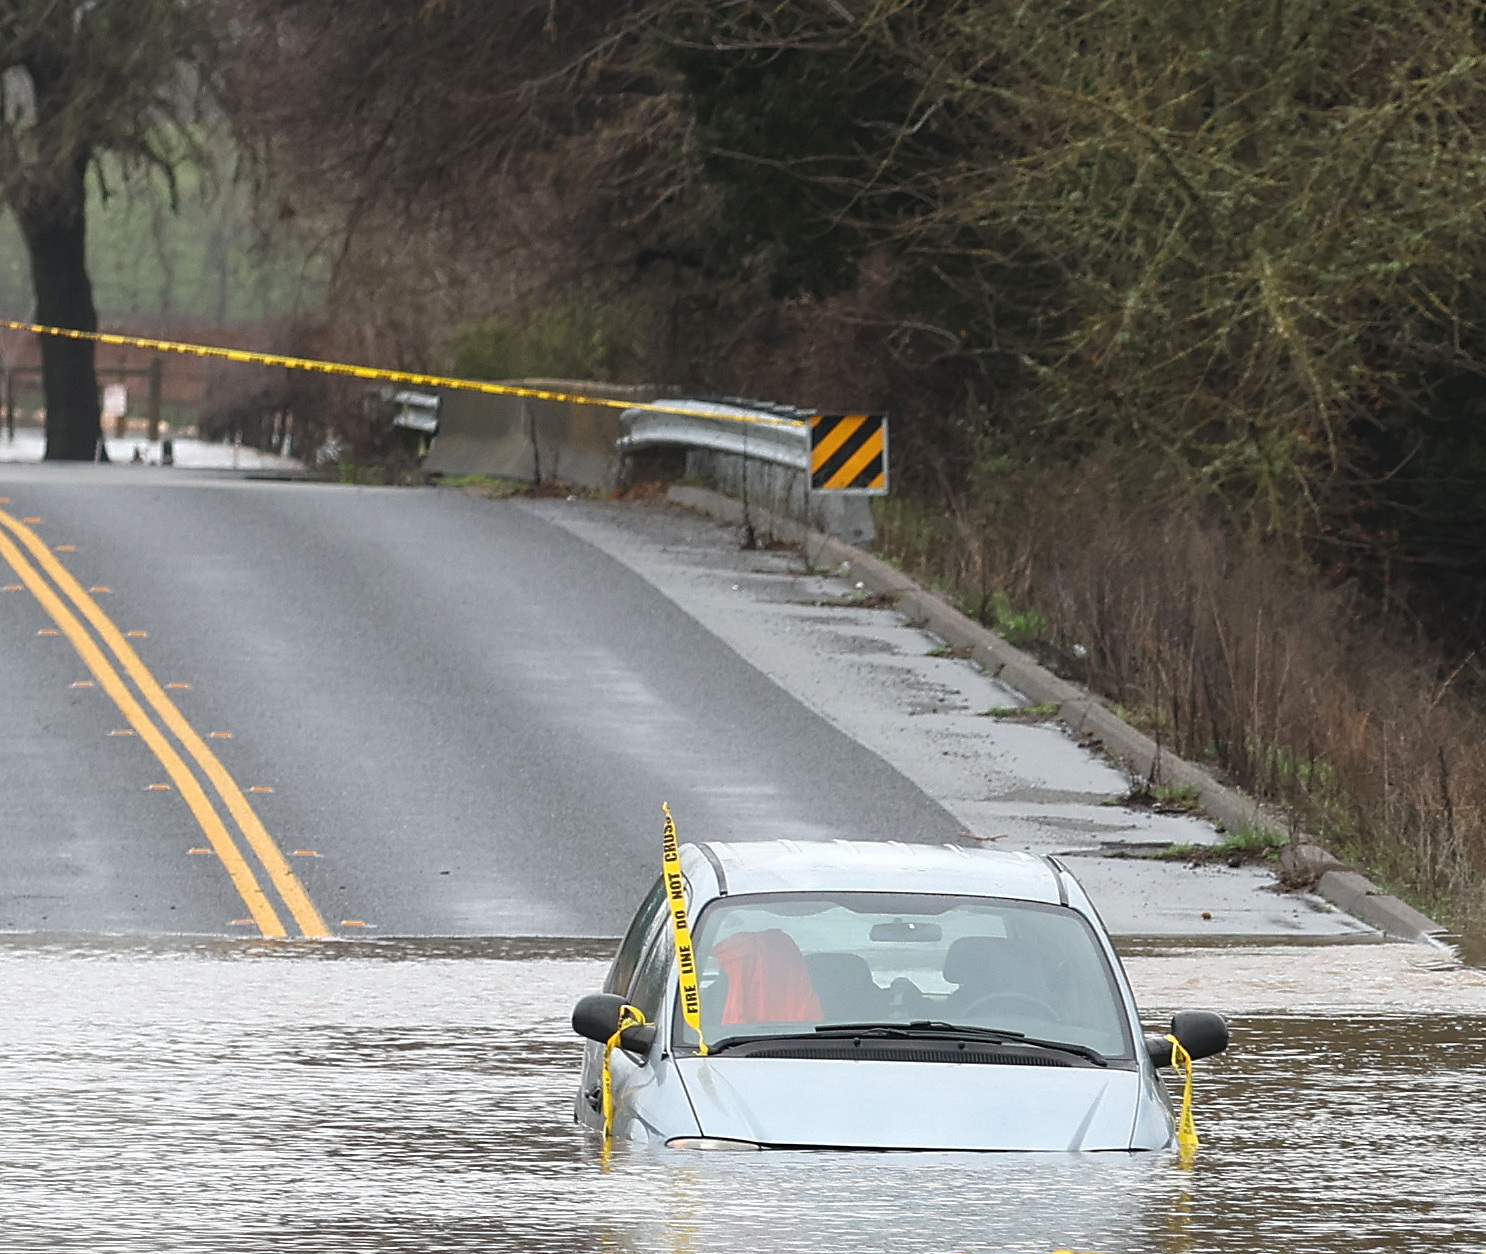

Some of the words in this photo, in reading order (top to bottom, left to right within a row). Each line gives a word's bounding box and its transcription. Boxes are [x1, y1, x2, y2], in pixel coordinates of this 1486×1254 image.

[668, 873, 683, 900] NOT
[674, 910, 687, 929] DO
[679, 945, 693, 974] LINE
[684, 984, 698, 1014] FIRE
